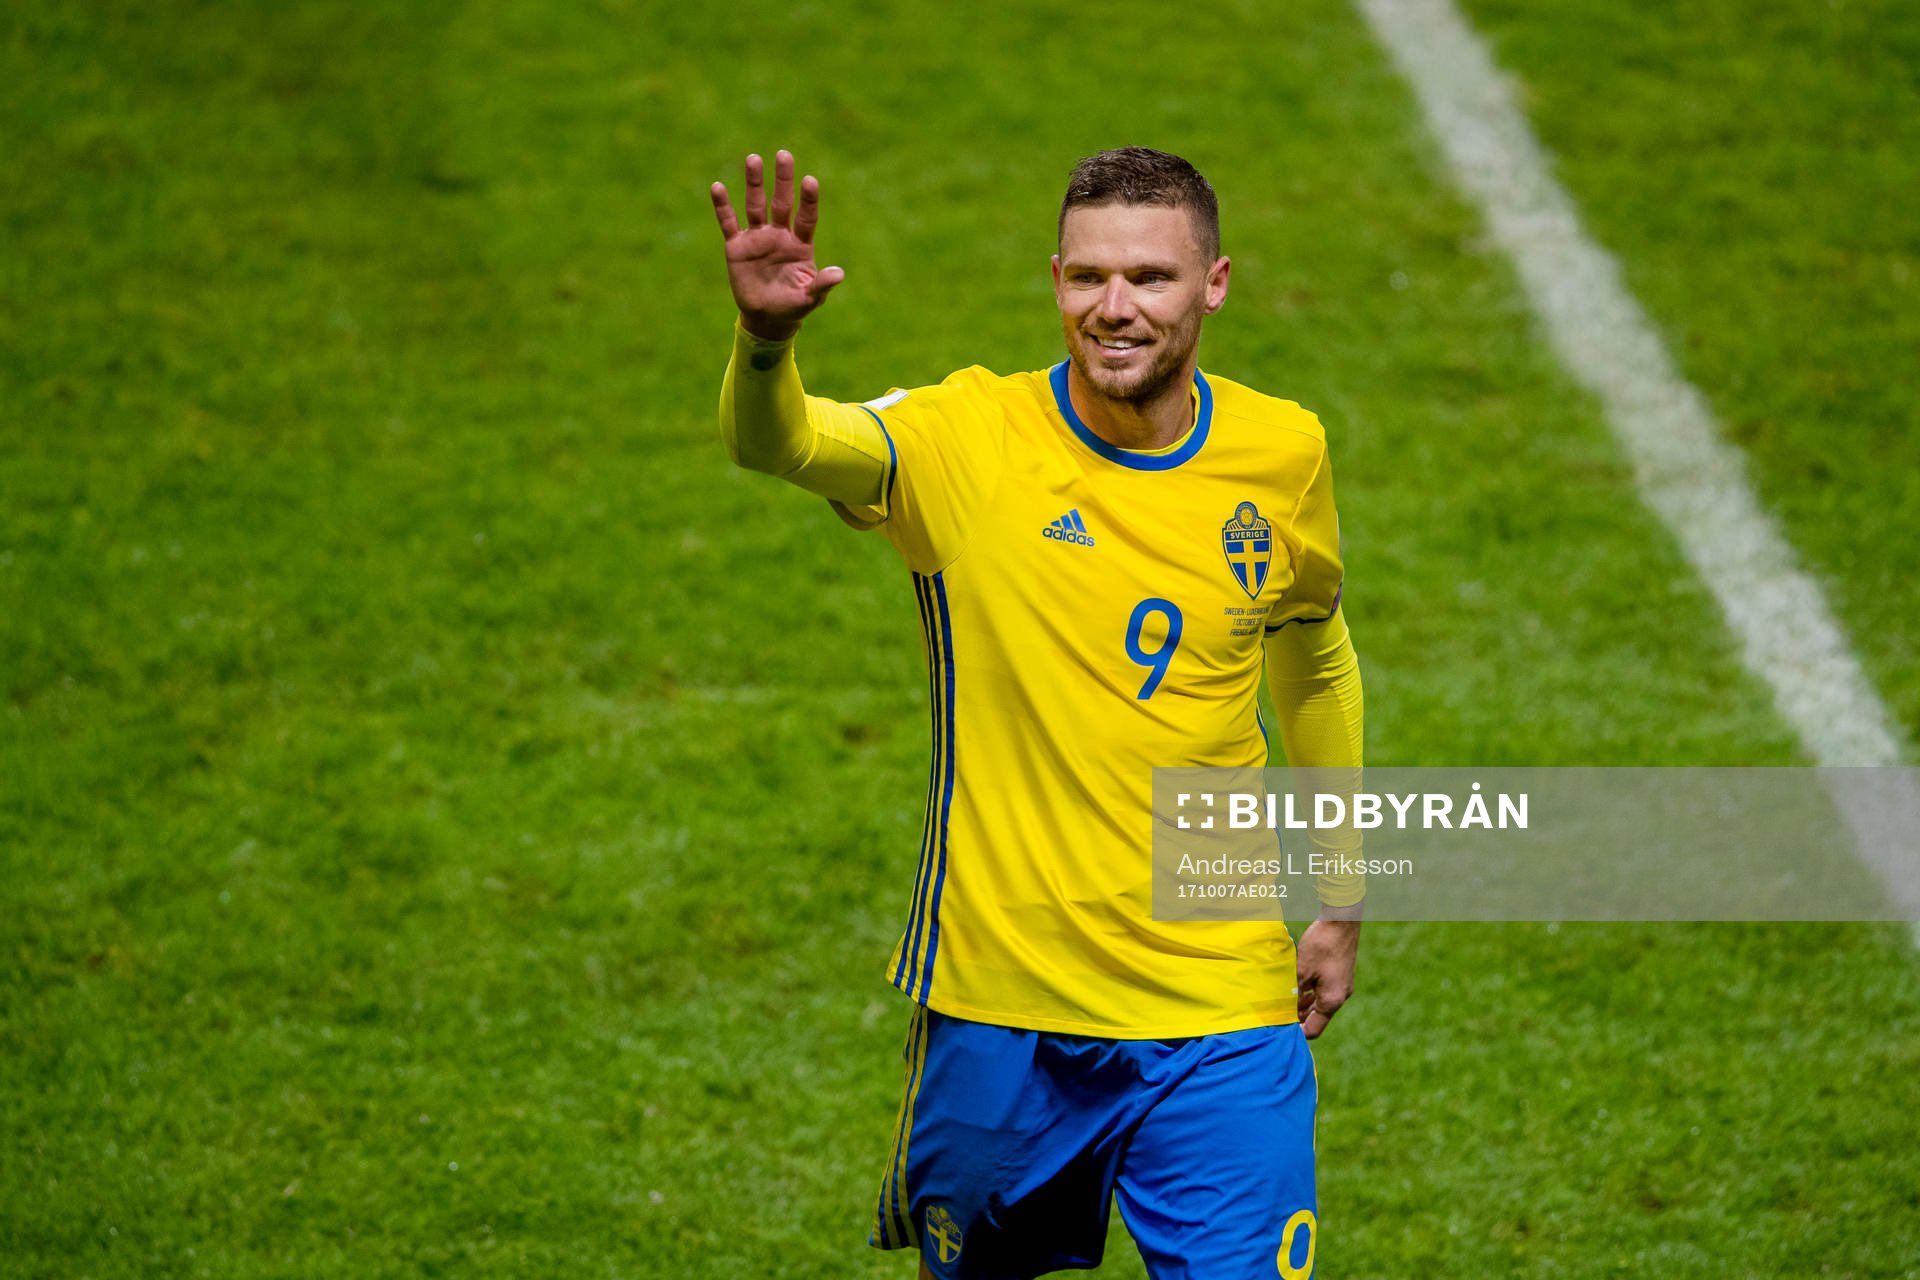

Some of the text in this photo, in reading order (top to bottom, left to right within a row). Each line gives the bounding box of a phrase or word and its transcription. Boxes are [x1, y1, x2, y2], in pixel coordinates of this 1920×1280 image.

[1042, 527, 1095, 547] adidas
[1230, 531, 1265, 540] SVERIGE
[1125, 597, 1183, 700] 9
